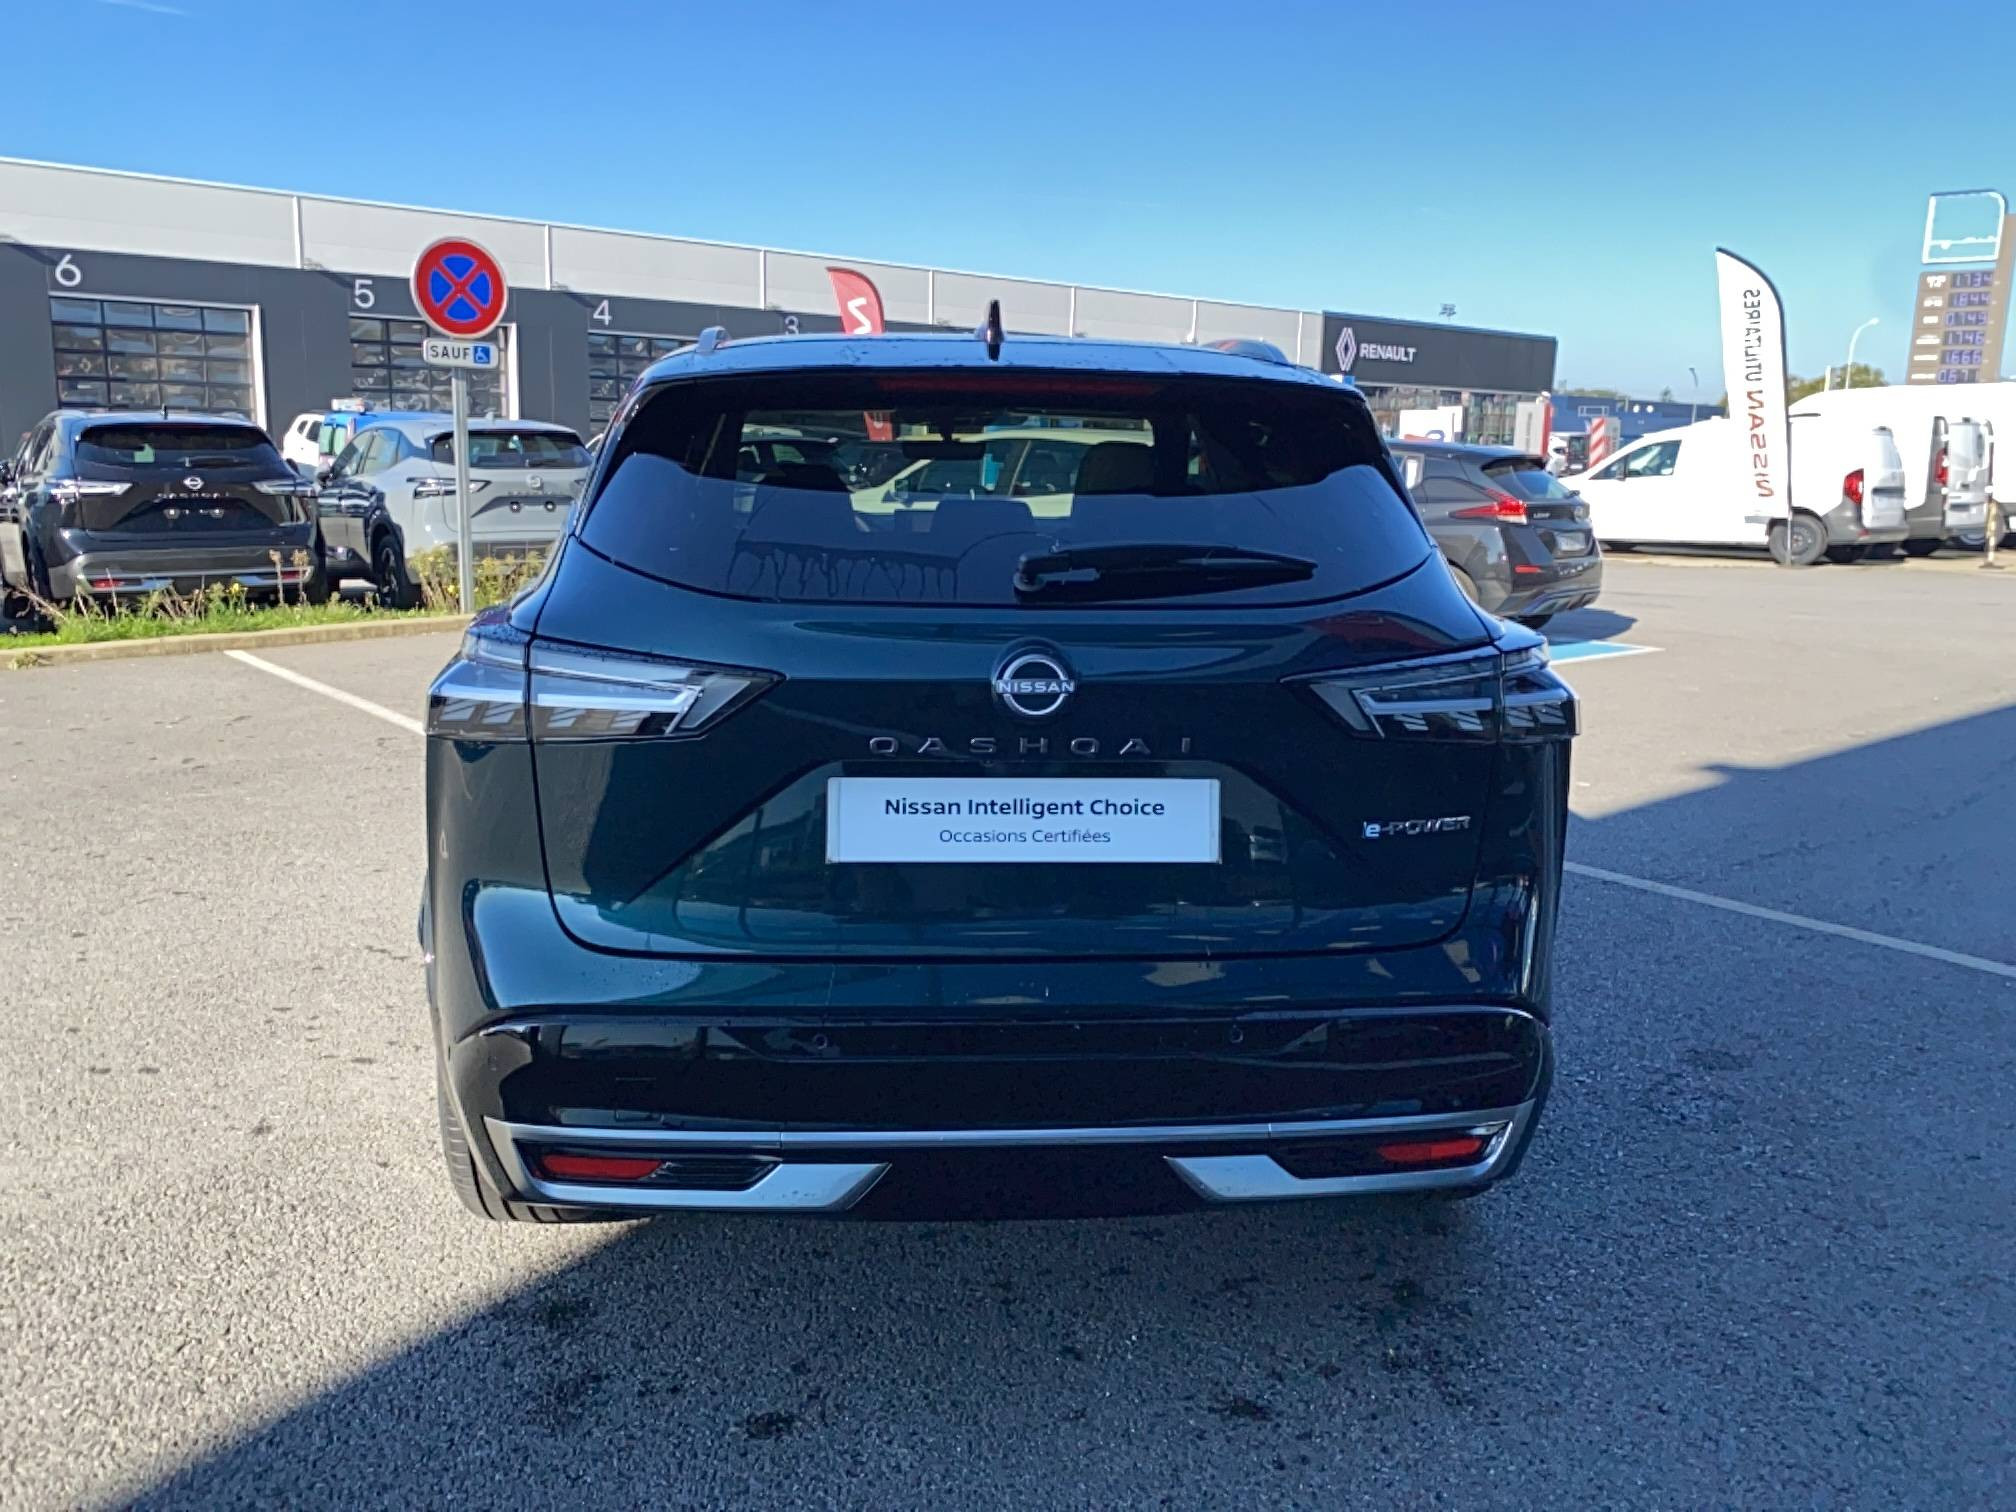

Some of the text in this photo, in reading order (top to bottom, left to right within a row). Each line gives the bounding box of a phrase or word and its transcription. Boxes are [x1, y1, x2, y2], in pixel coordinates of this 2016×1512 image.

[55, 253, 82, 287] 6
[354, 279, 375, 309] 5
[593, 299, 612, 326] 4
[784, 315, 800, 335] 3
[429, 345, 471, 360] SAUF
[1359, 343, 1417, 363] RENAULT
[998, 680, 1075, 694] NISSAN
[884, 797, 1165, 820] Nissan Intelligent Choice
[939, 828, 1112, 844] Occasions Certifiées
